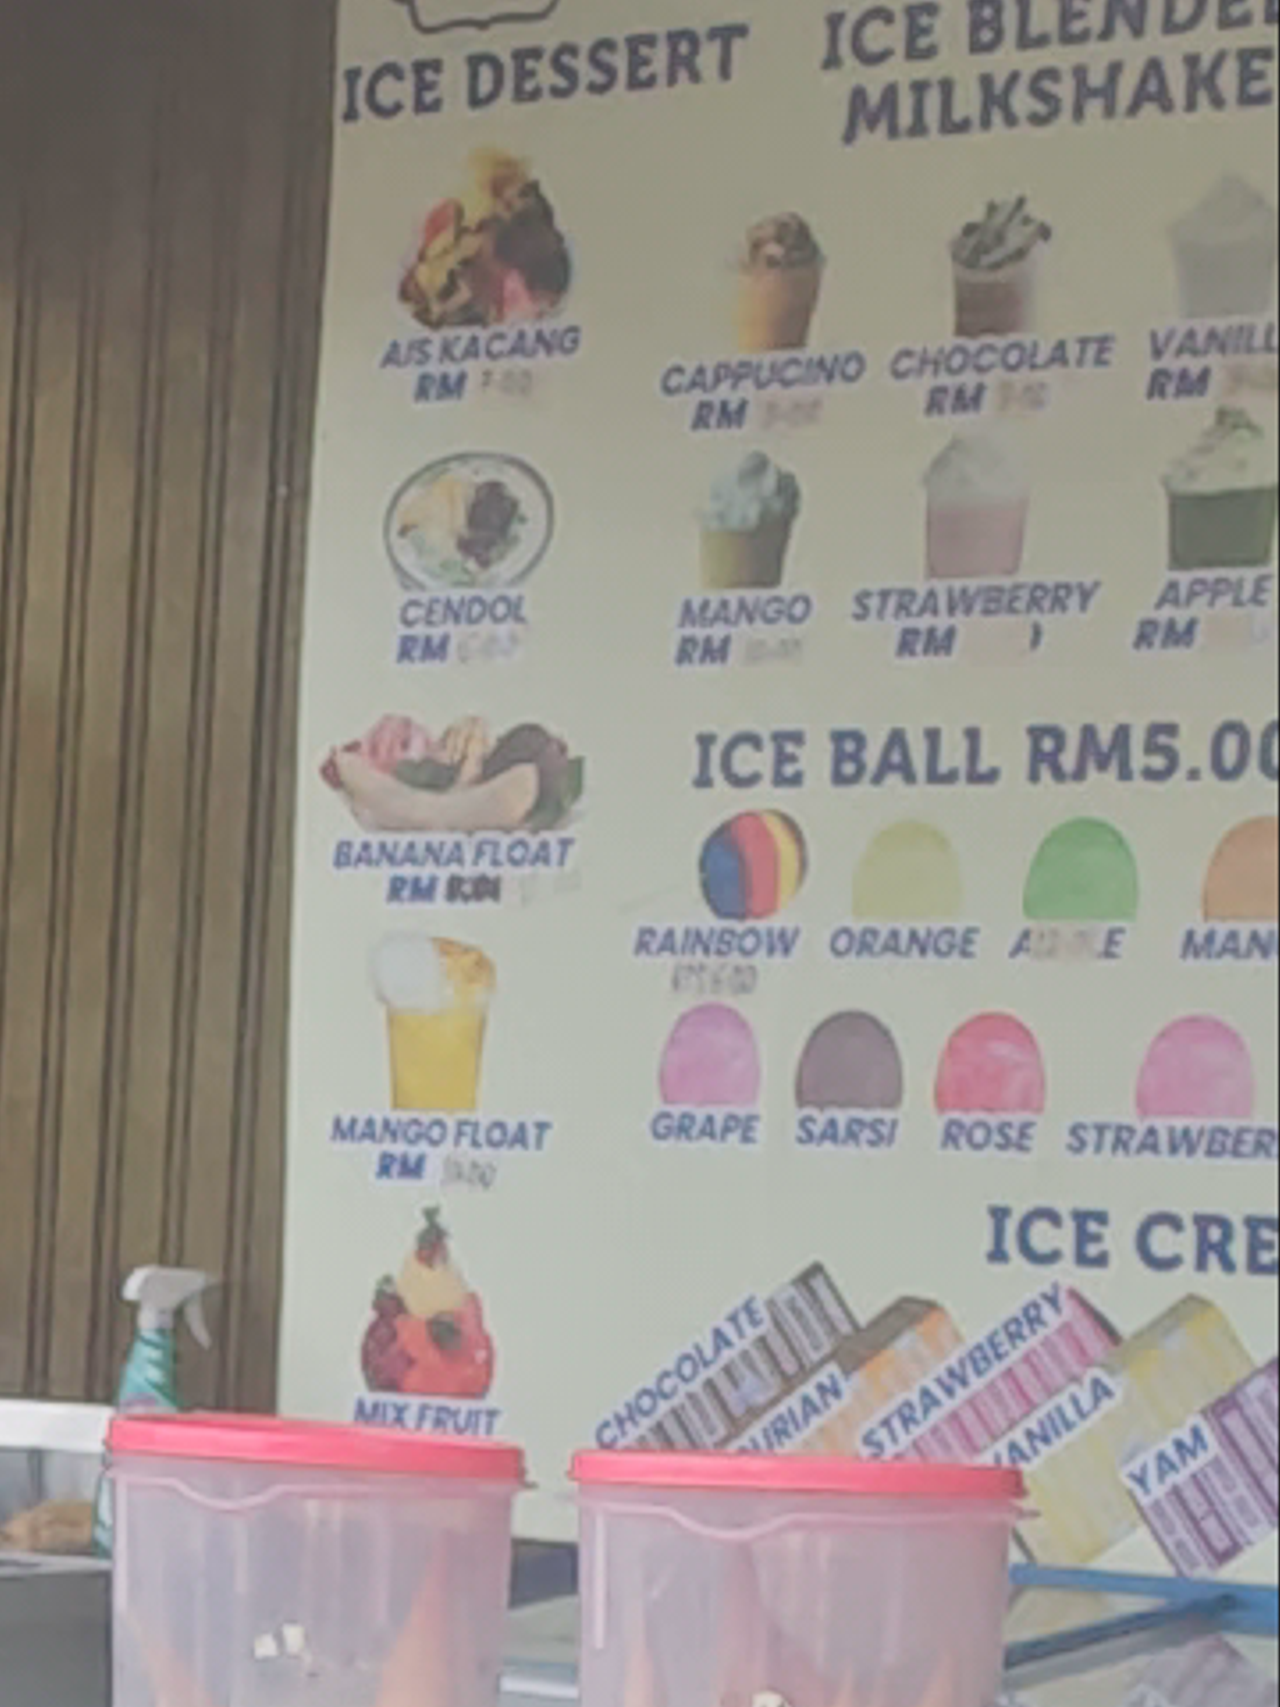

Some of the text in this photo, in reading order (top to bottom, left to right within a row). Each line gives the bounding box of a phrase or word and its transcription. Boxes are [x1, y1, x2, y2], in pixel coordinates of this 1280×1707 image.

[821, 2, 940, 71] ICE
[342, 24, 750, 123] ICE DESSERT
[843, 47, 1275, 145] MILKSHAKE
[380, 326, 581, 369] AIS KACANG
[889, 335, 1115, 380] CHOCOLATE
[414, 372, 468, 403] RM
[660, 351, 867, 397] CAPPUCINO
[1146, 367, 1212, 401] RM
[691, 399, 748, 431] RM
[924, 383, 987, 418] RM
[851, 582, 1101, 622] STRAWBERRY
[1154, 575, 1273, 611] APPLE
[398, 595, 529, 629] CENDOL
[678, 595, 813, 629] MANGO
[396, 634, 450, 664] RM
[674, 636, 732, 665] RM
[894, 626, 958, 658] RM
[1132, 618, 1199, 651] RM
[691, 731, 808, 789] ICE
[829, 727, 1002, 787] BALL
[333, 838, 576, 869] BANANA FLOAT
[386, 875, 440, 904] RM
[633, 926, 801, 959] RAINBOW
[829, 926, 981, 959] ORANGE
[330, 1115, 553, 1152] MANGO FLOAT
[650, 1112, 761, 1145] GRAPE
[795, 1115, 900, 1149] SARSI
[940, 1121, 1037, 1155] ROSE
[375, 1150, 427, 1180] RM
[986, 1205, 1111, 1269] ICE
[595, 1295, 765, 1450] CHOCOLATE
[861, 1280, 1062, 1458] STRAWBERRY
[354, 1397, 502, 1436] MIX FRUIT
[994, 1376, 1115, 1468] ANILLA
[1127, 1424, 1210, 1497] YAM
